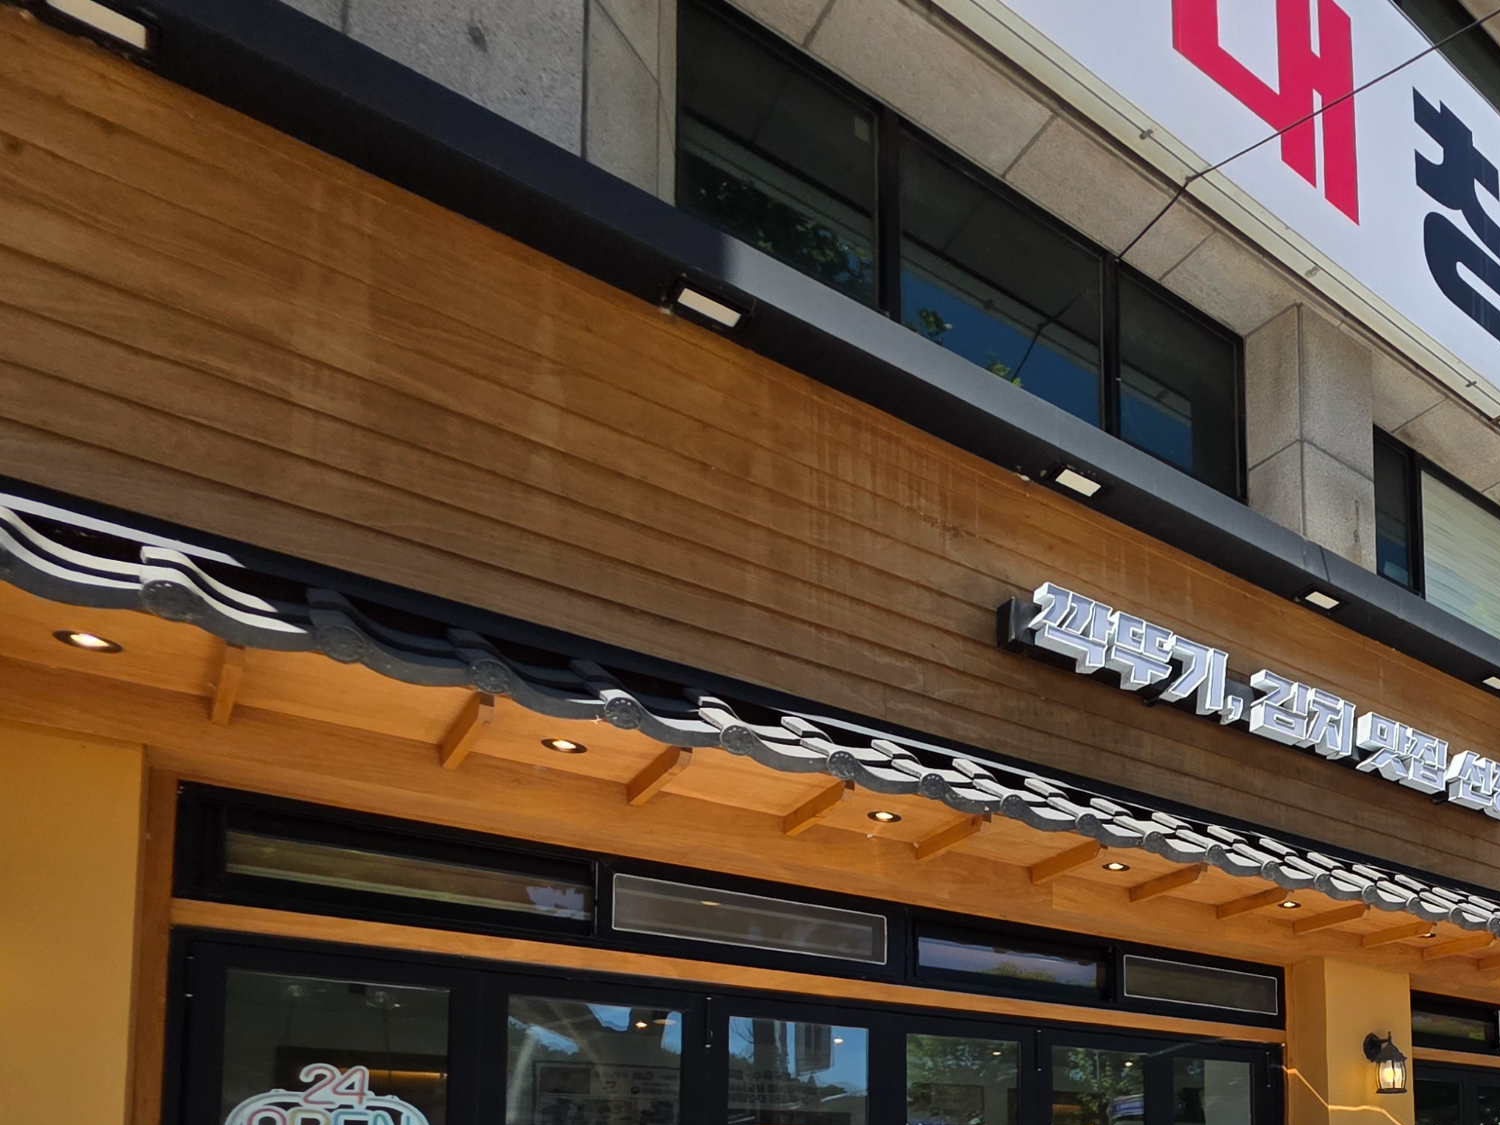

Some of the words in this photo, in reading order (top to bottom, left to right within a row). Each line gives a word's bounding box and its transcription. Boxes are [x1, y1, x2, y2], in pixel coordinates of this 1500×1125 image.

[1249, 669, 1357, 760] 김치
[1357, 711, 1449, 795] 맛집
[301, 1063, 369, 1106] 24
